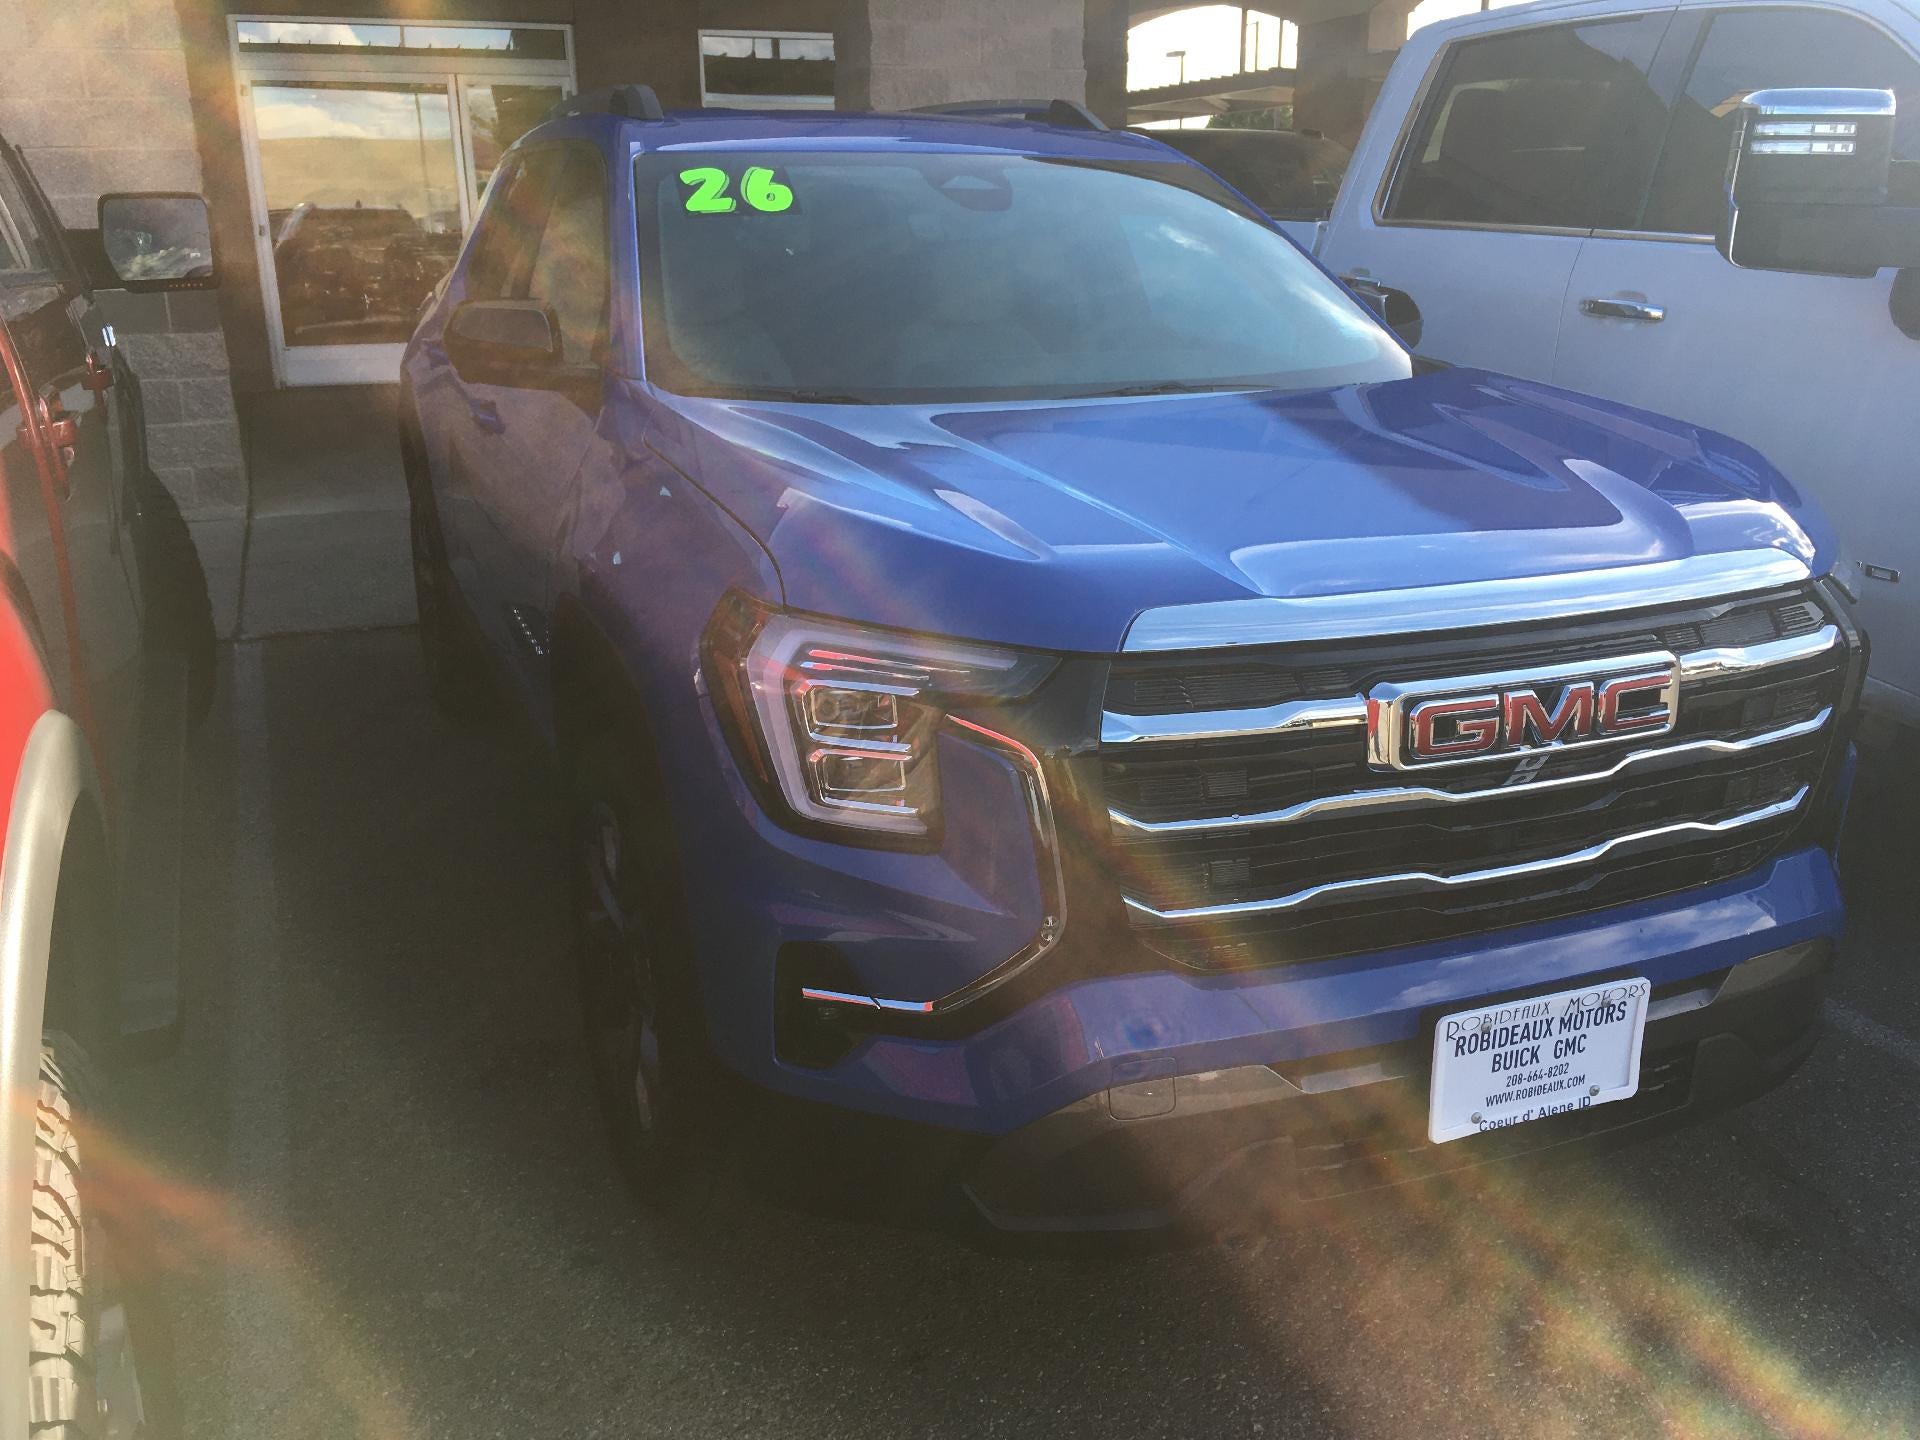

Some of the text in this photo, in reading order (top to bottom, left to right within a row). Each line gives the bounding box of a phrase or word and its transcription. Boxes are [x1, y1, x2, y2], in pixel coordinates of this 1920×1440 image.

[679, 166, 793, 213] 26
[1409, 670, 1673, 759] GMC
[1564, 983, 1647, 1016] MOTORS
[1455, 1001, 1627, 1057] ROBIDEAUX MOTORS
[1491, 1034, 1587, 1073] BUICK GMC
[1486, 1074, 1586, 1107] WWW.ROBIDEAUX.COM
[1506, 1062, 1570, 1088] 208-664-8202
[1480, 1114, 1519, 1132] Coeur
[1538, 1101, 1574, 1118] Alene
[1578, 1096, 1591, 1109] ID
